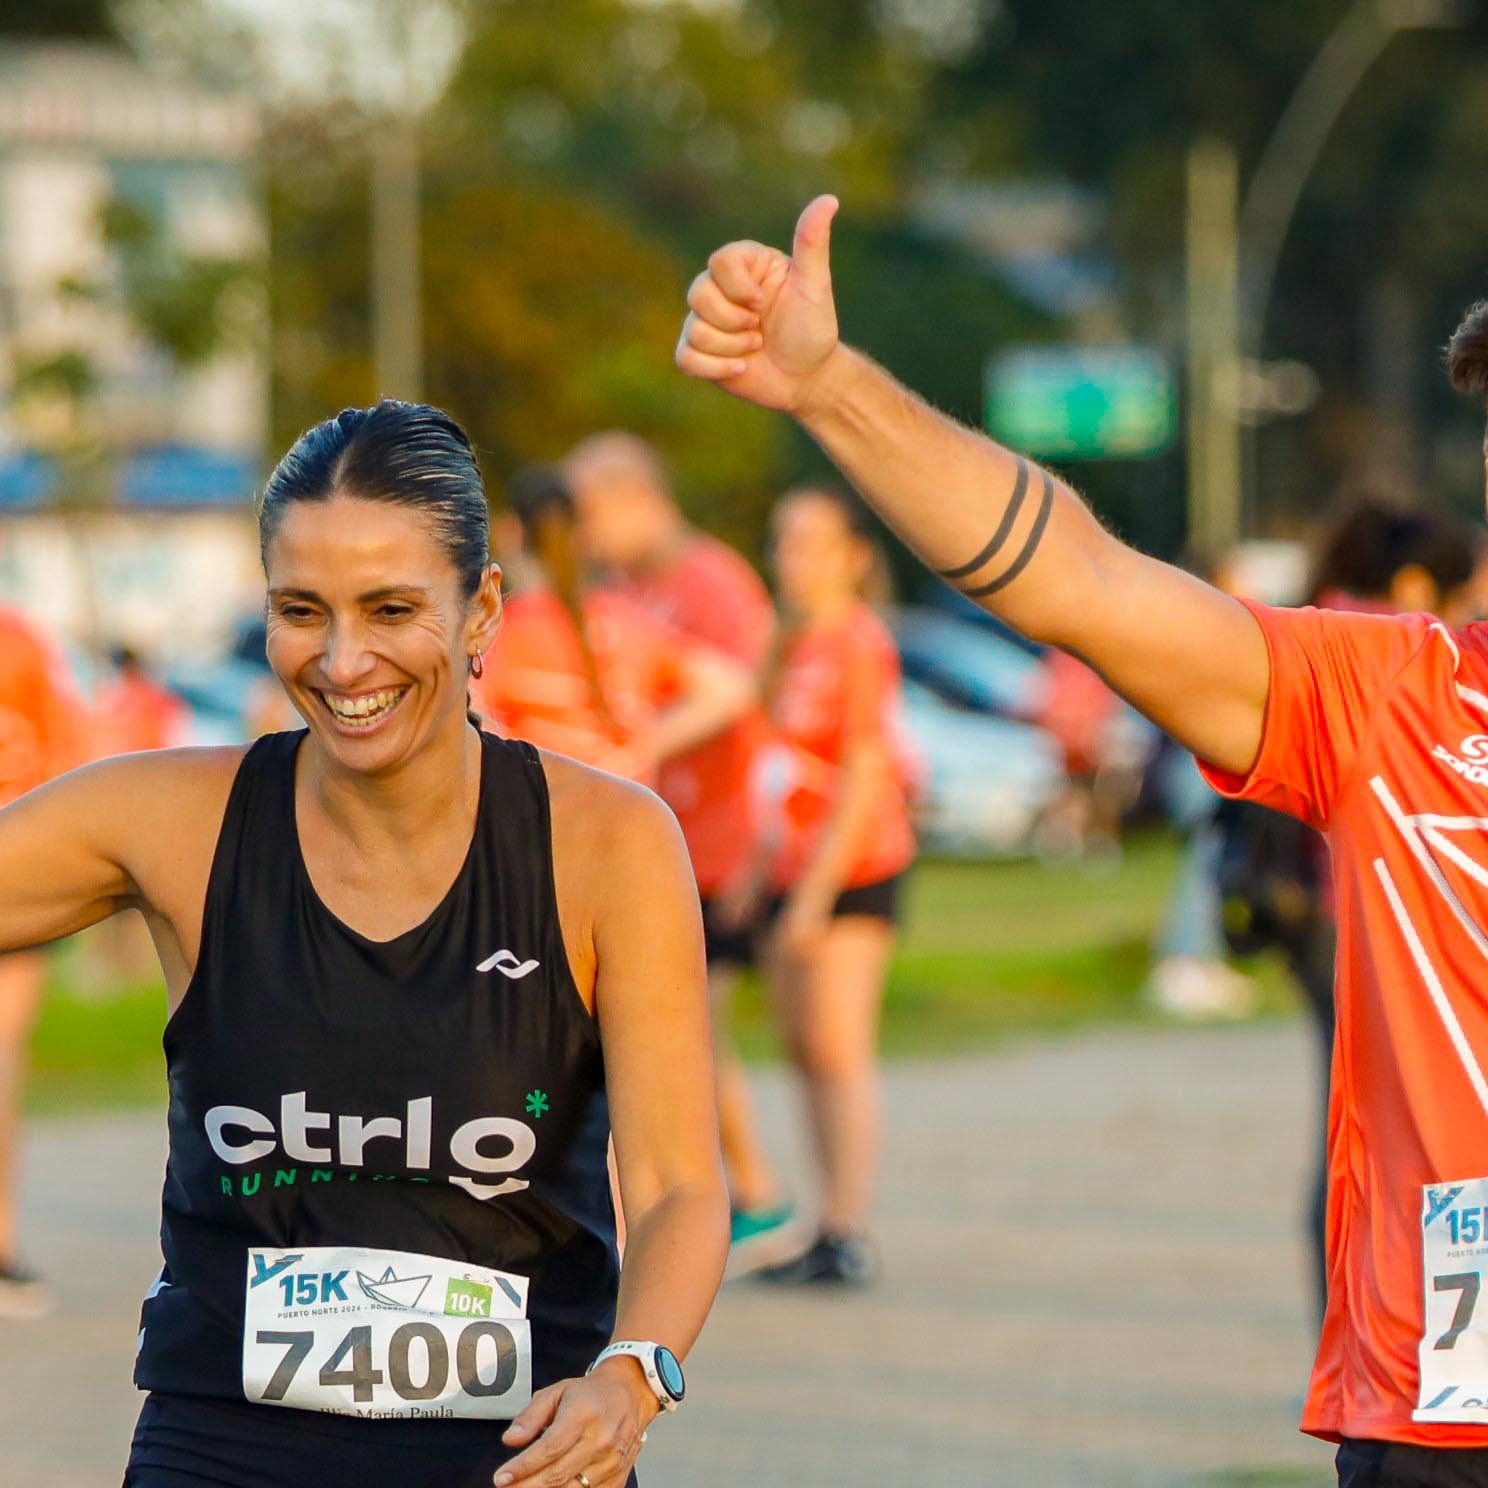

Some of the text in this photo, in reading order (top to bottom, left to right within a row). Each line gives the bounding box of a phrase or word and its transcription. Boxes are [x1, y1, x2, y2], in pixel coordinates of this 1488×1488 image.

[220, 1168, 430, 1196] RUNN
[279, 1270, 487, 1317] 15K 10K
[277, 1309, 310, 1320] PUERTO
[311, 1306, 339, 1317] NORTE
[341, 1304, 361, 1313] 2026
[256, 1321, 518, 1403] 7400
[357, 1407, 404, 1419] María
[411, 1405, 454, 1419] Paula
